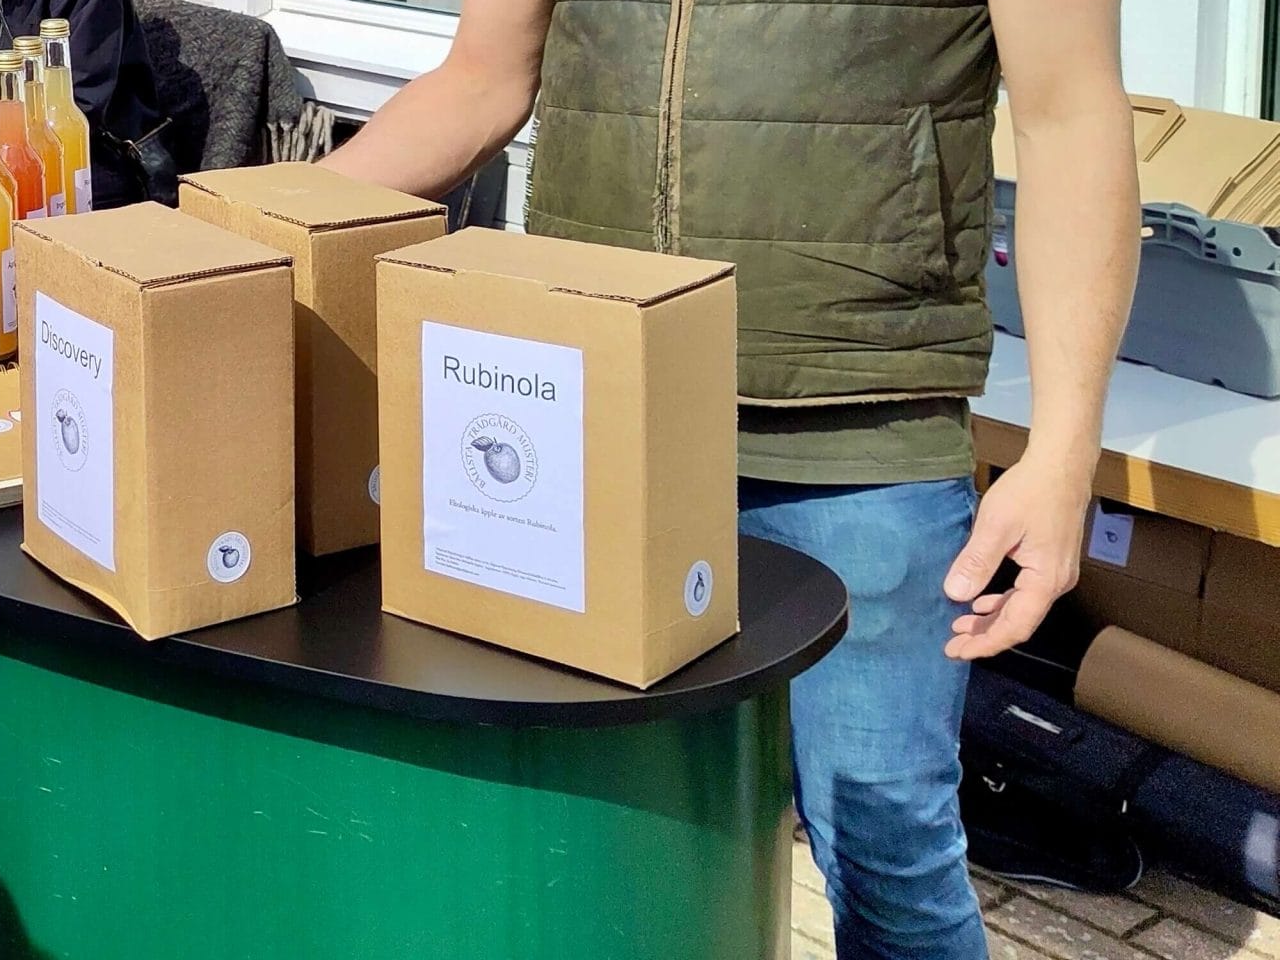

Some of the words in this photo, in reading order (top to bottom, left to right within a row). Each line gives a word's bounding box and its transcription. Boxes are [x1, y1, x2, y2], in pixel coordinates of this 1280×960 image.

[41, 320, 102, 379] Discovery
[443, 355, 557, 402] Rubinola
[517, 434, 535, 483] MUSTERI
